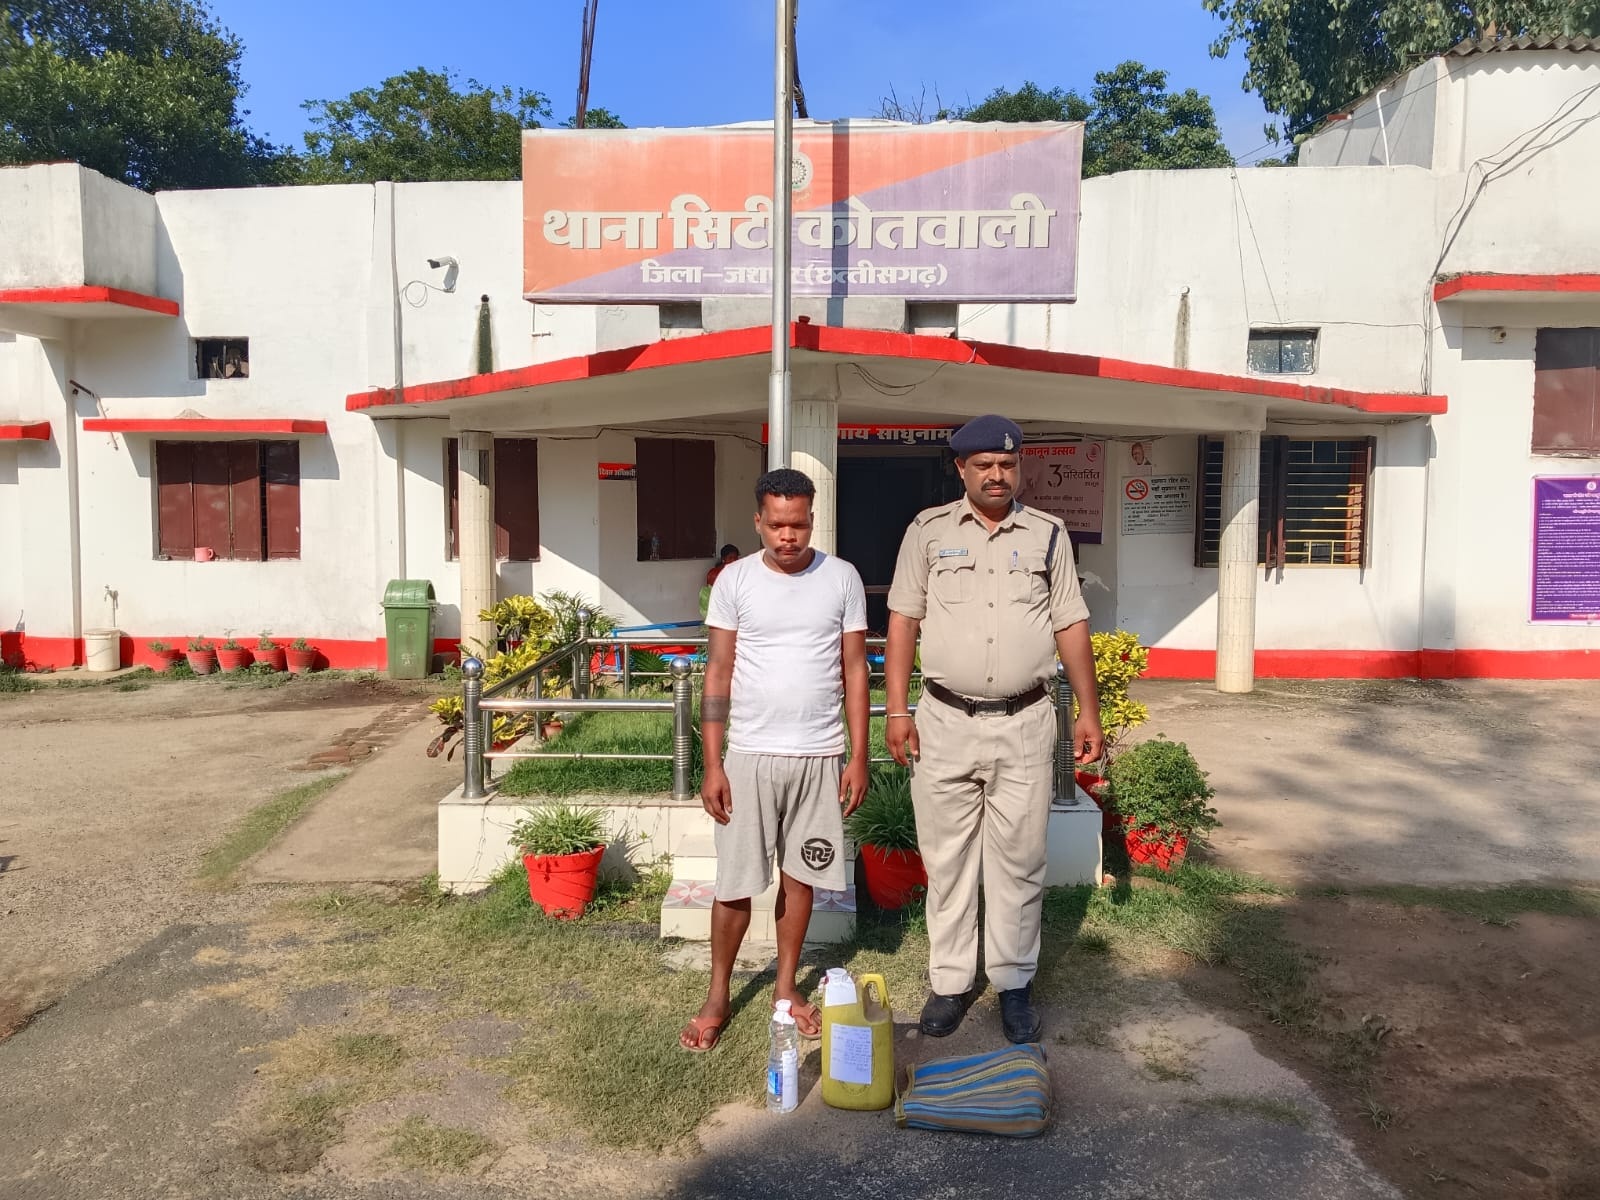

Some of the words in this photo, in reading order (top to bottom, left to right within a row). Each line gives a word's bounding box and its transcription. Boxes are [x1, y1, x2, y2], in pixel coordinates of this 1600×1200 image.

[543, 209, 663, 250] थाना
[668, 194, 774, 251] सिटी
[794, 192, 1058, 250] कोतवाली
